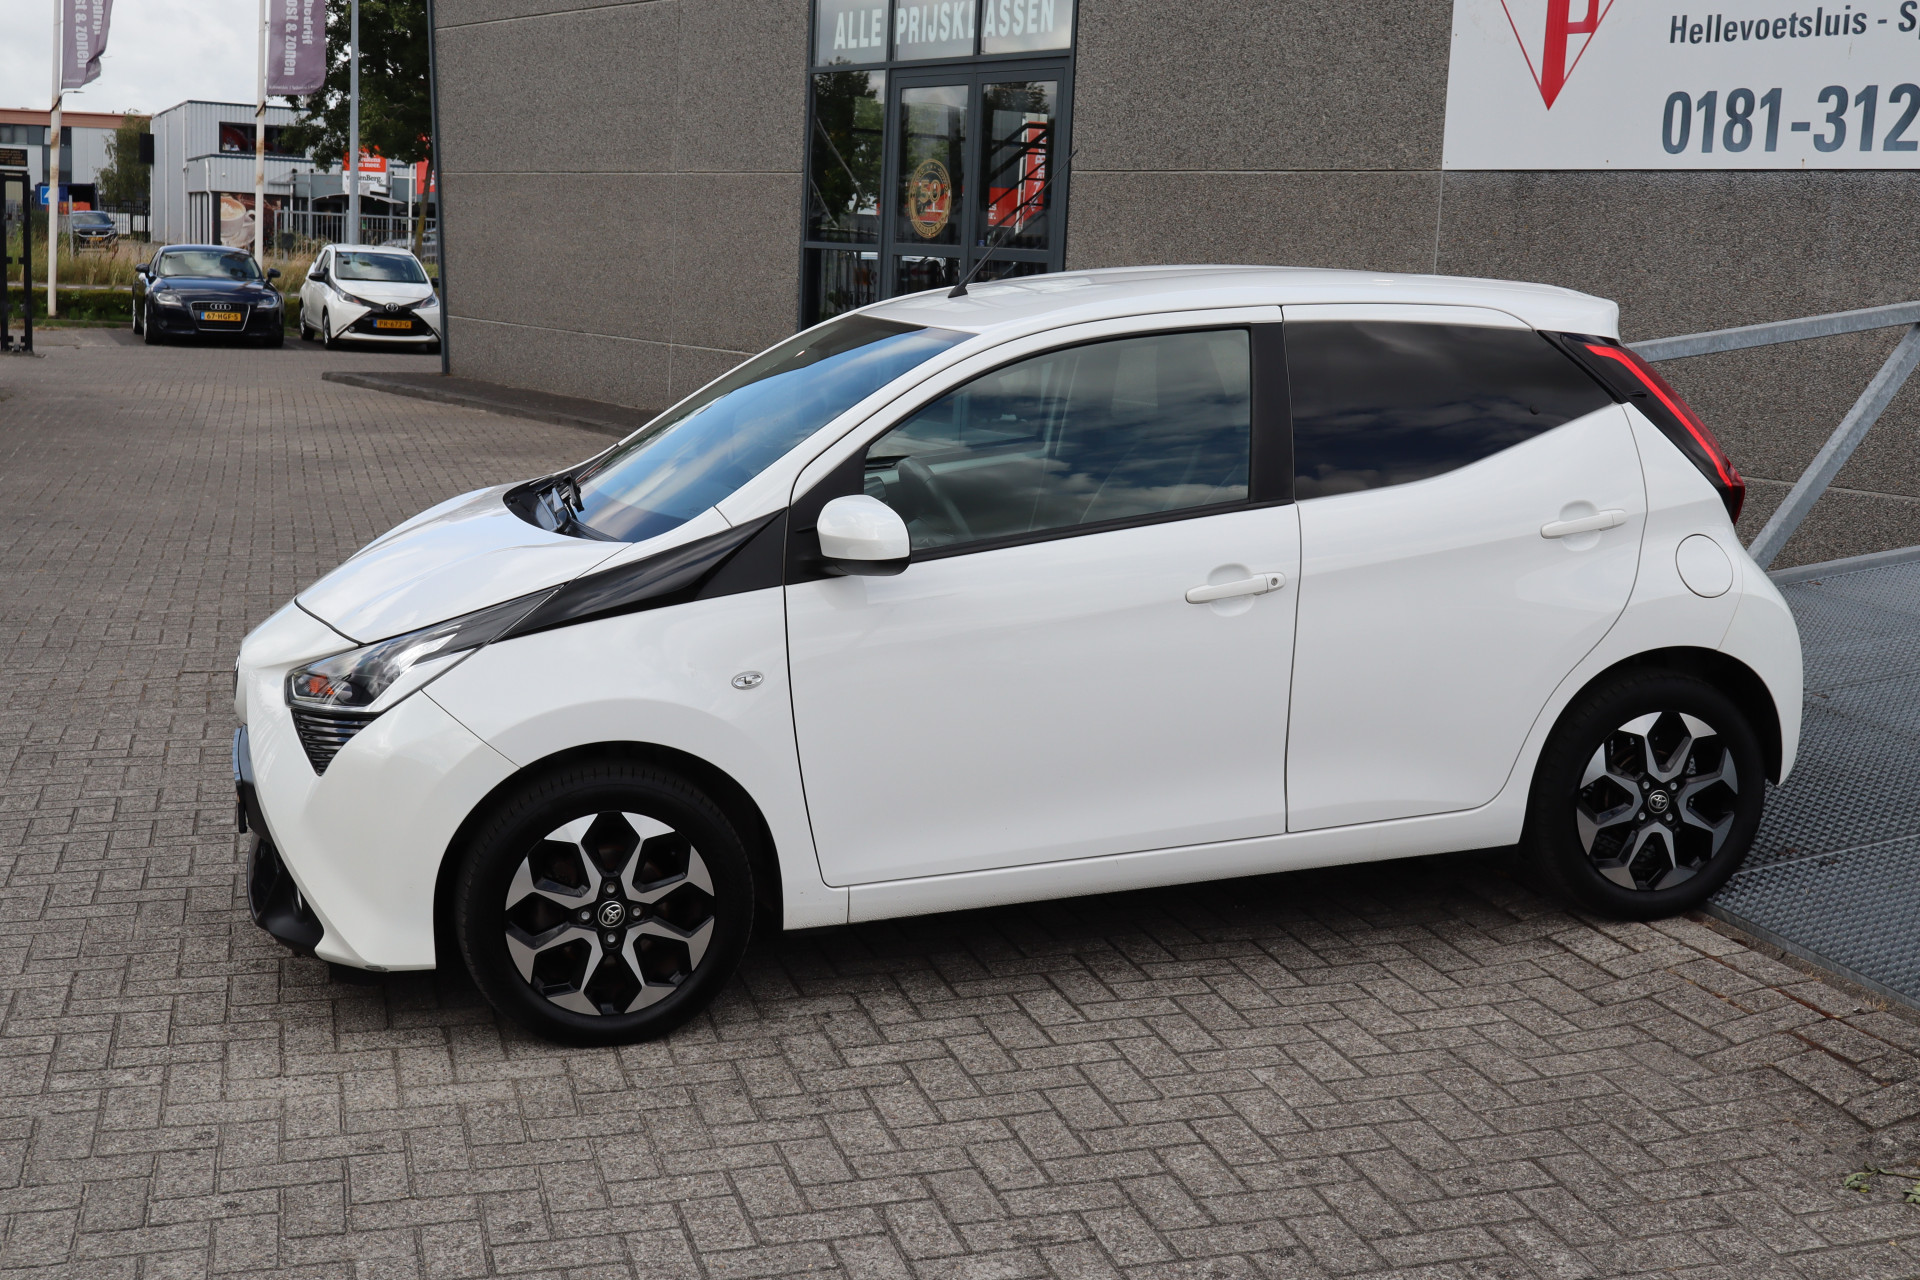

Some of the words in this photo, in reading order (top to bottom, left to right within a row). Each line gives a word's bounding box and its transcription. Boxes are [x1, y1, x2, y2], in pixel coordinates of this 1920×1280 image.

[75, 13, 87, 24] &
[285, 23, 298, 33] &
[834, 9, 883, 50] ALLE
[895, 0, 1055, 46] PRIJSKLASSEN
[1669, 5, 1867, 45] Hellevoetsluis
[75, 25, 89, 68] zonen
[284, 35, 297, 76] zonen
[1661, 83, 1920, 155] 0181-312
[919, 179, 941, 203] 50
